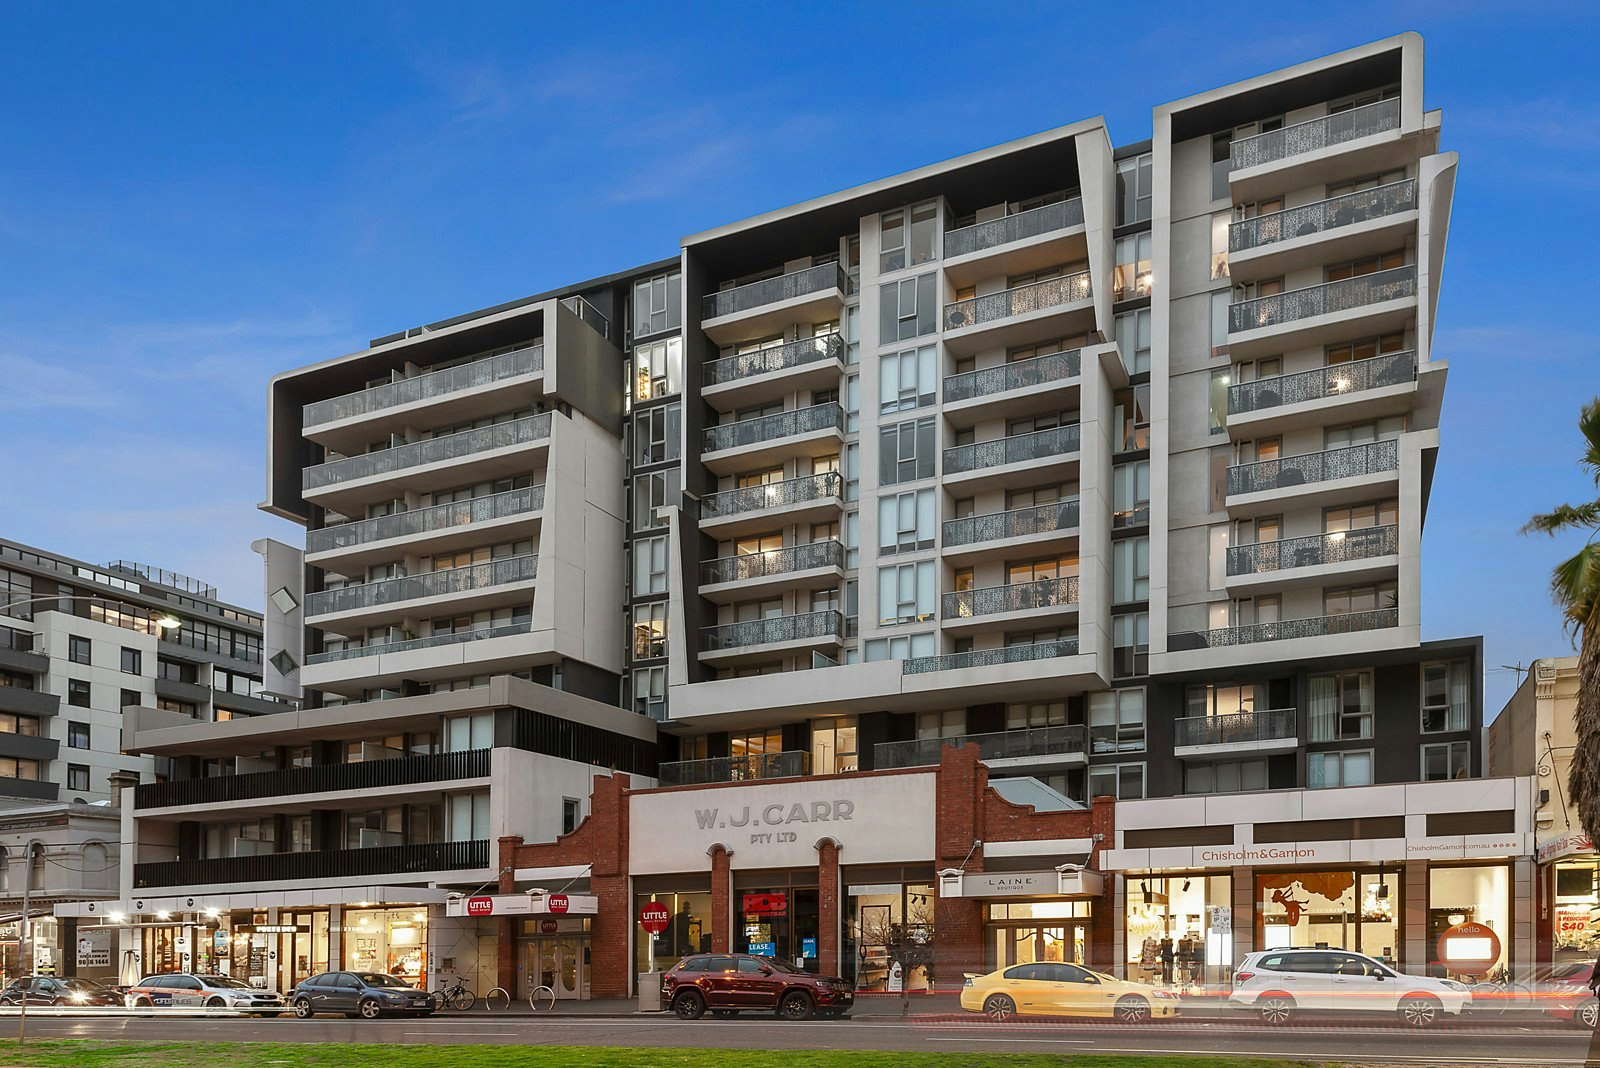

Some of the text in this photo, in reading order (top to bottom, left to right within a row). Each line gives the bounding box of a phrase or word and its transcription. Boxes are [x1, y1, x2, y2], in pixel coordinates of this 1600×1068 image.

[750, 831, 797, 844] PTY LTD
[1407, 843, 1490, 852] ChisholmGamoncom.au
[1201, 848, 1315, 861] Chisholm&Gamon
[469, 901, 491, 909] LITTLE
[643, 911, 667, 920] LITTLE
